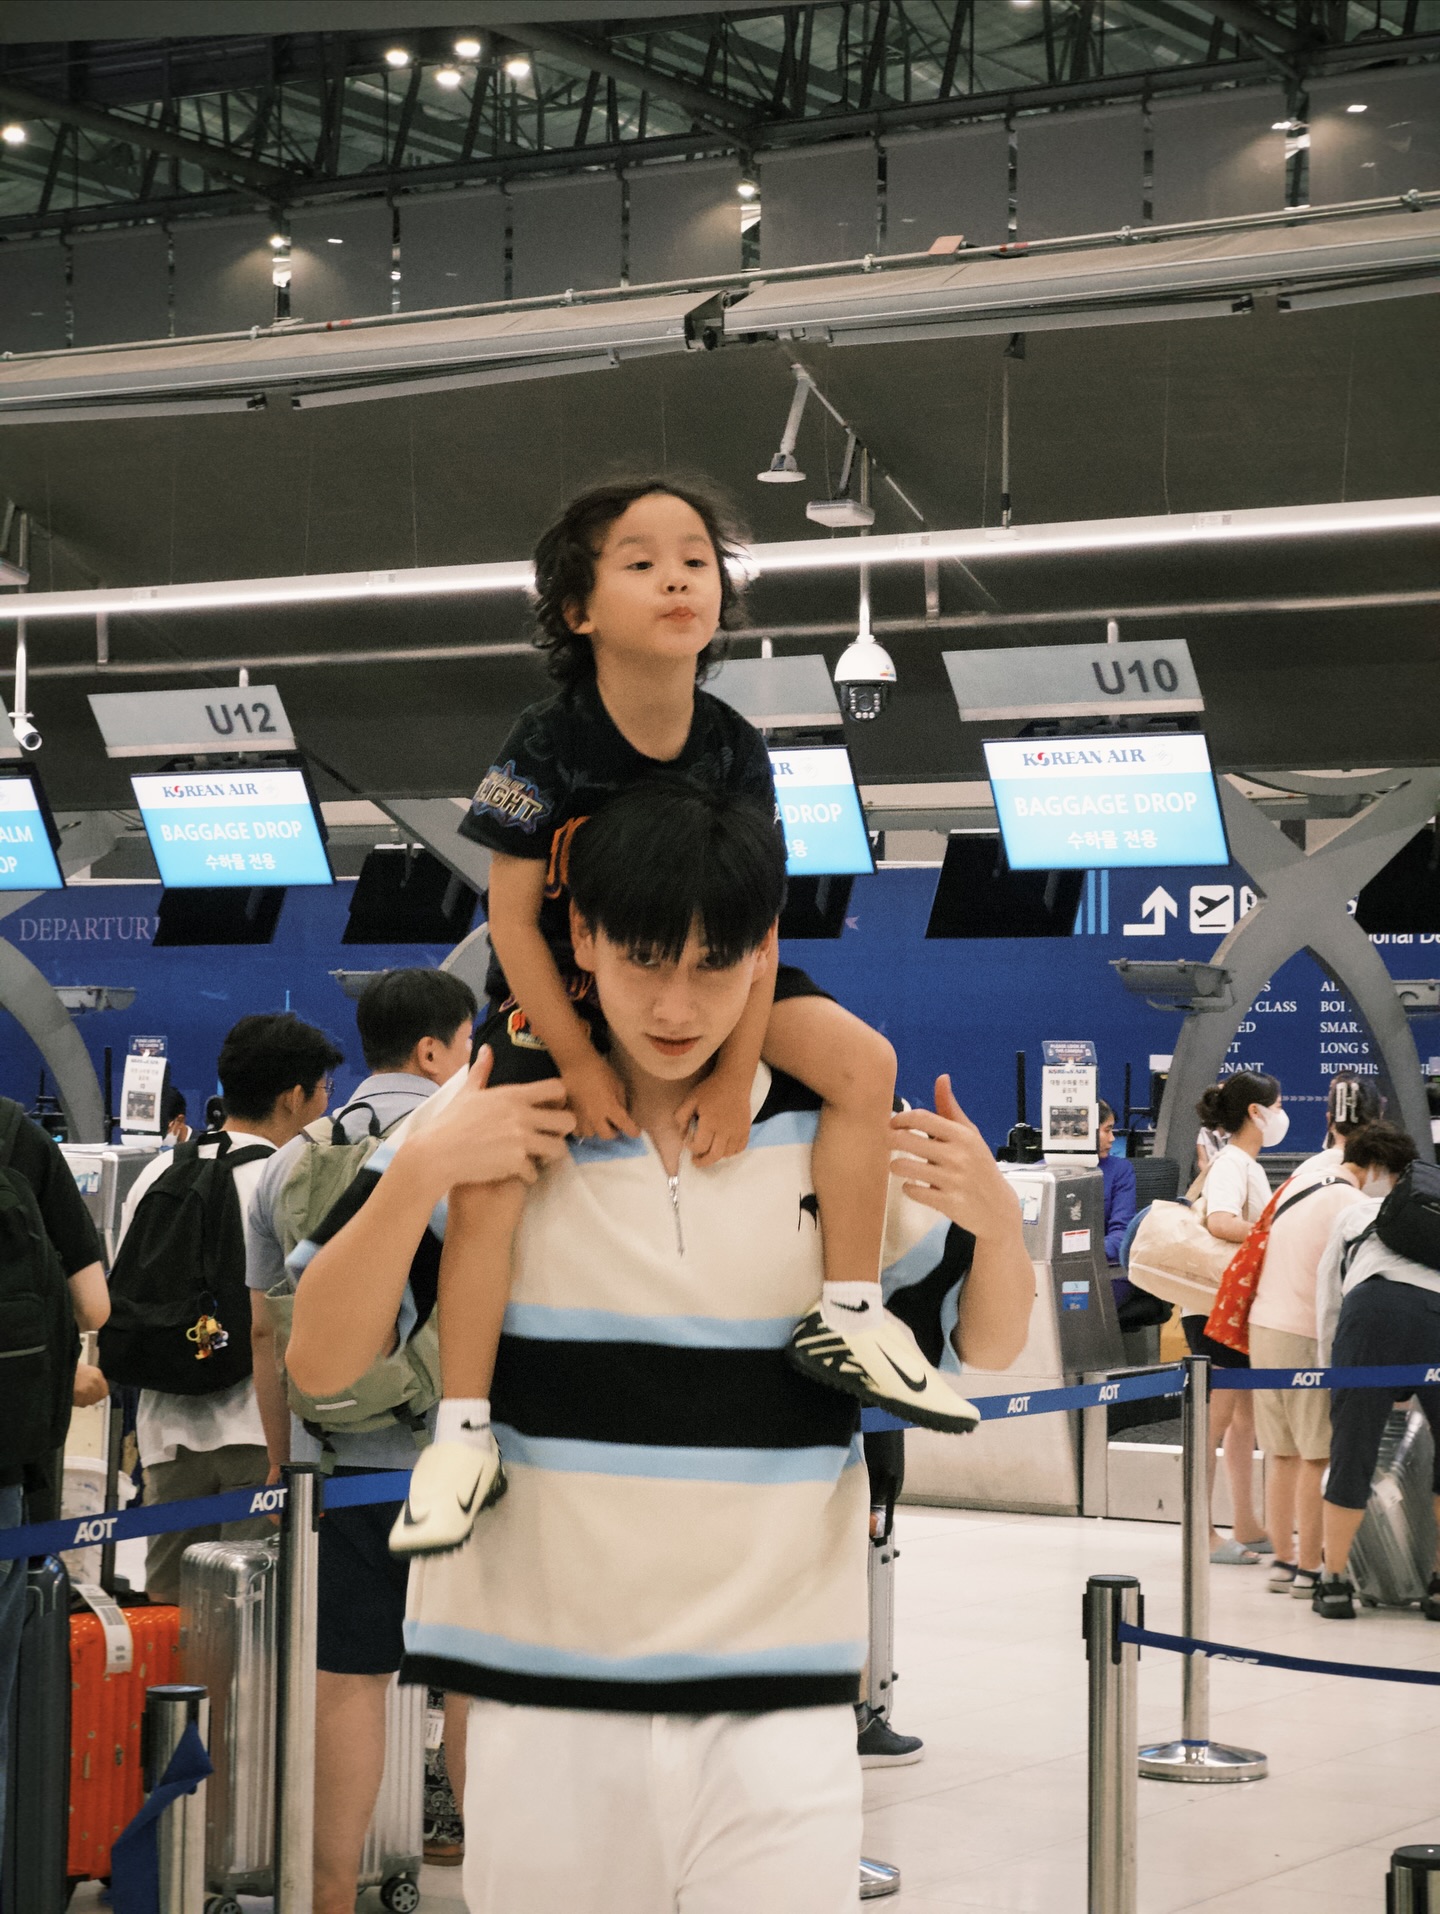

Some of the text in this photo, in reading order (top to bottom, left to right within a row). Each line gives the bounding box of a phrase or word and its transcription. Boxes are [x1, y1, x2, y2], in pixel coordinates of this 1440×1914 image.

[1092, 658, 1179, 695] U10
[205, 702, 277, 735] U12
[1022, 748, 1146, 767] KOREAN AIR
[162, 783, 258, 798] KOREAN AIR
[1014, 791, 1197, 817] BAGGAGE DROP
[783, 803, 842, 825] DROP
[160, 820, 302, 842] BAGGAGE DROP
[1067, 828, 1158, 850] 수하물 전용
[205, 852, 276, 871] 수하물 전용
[1255, 1000, 1298, 1013] CLASS
[1320, 1022, 1363, 1033] SMAR
[1320, 1042, 1359, 1054] LONG
[1291, 1372, 1325, 1387] AOT
[1098, 1383, 1120, 1401] AOT
[1007, 1396, 1030, 1414] AOT
[249, 1487, 288, 1514] AOT
[73, 1517, 118, 1544] AOT
